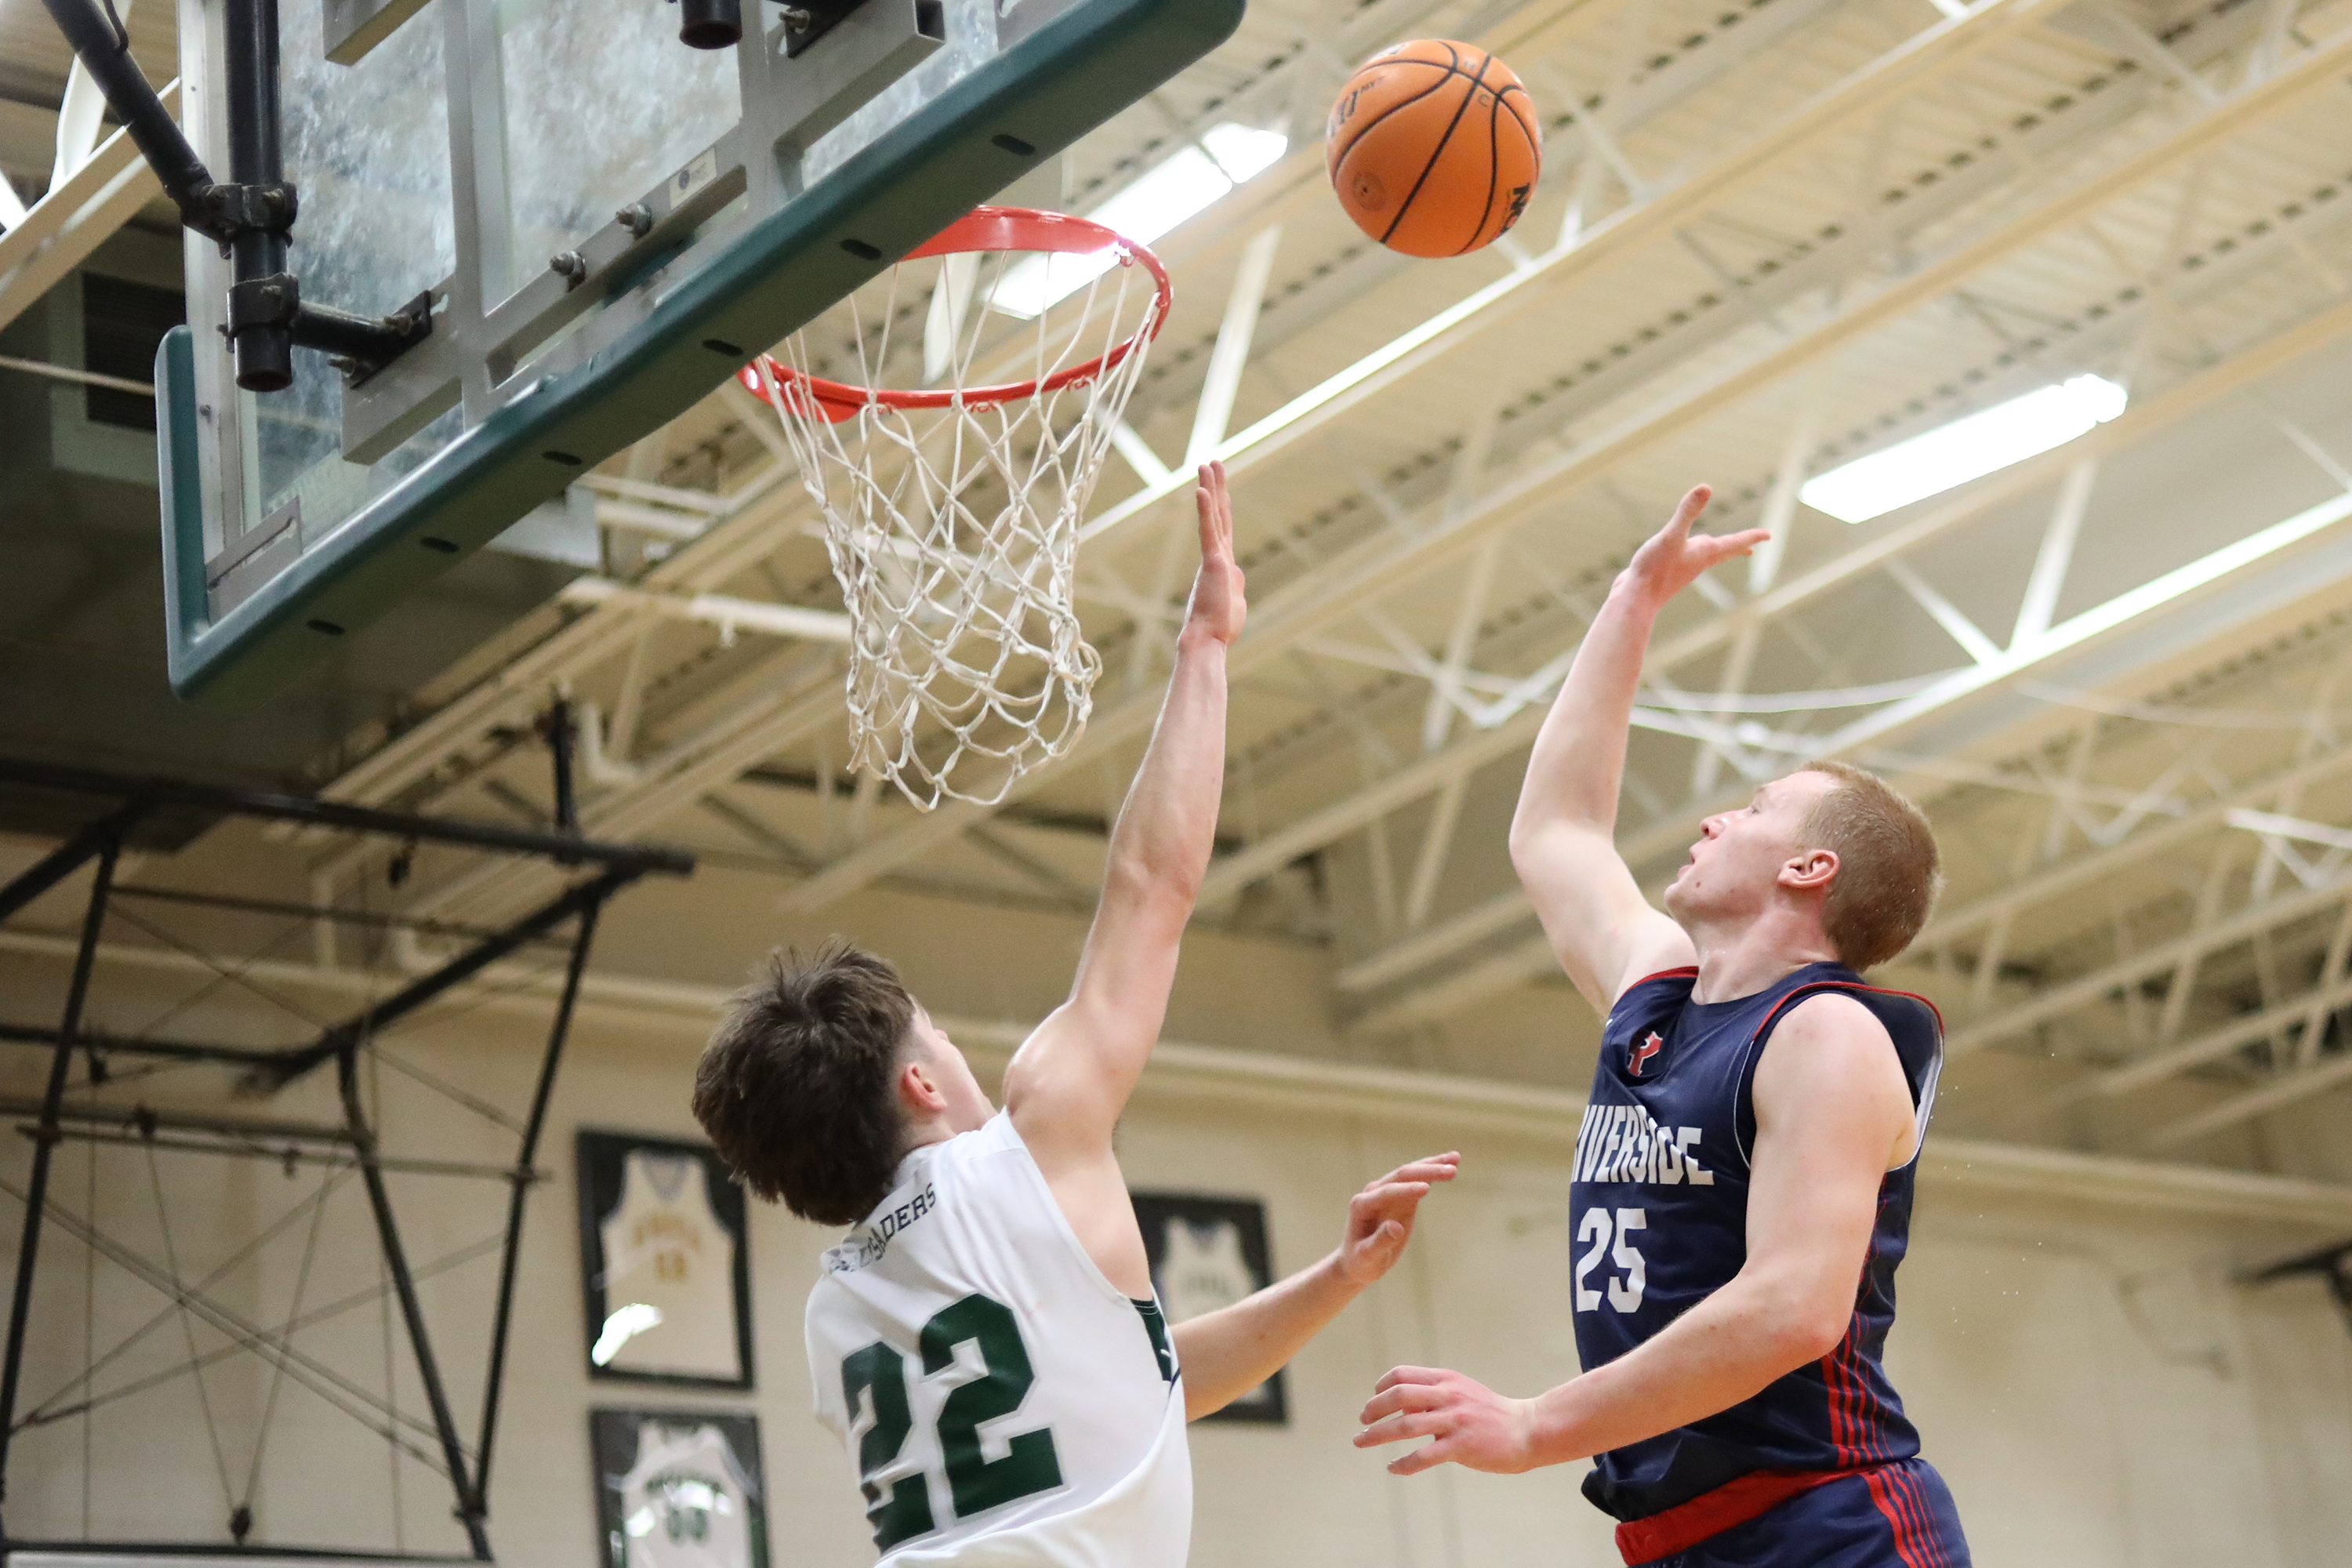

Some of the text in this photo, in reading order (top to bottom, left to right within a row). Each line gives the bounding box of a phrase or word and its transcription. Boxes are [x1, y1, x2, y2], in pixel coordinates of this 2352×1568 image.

[1571, 1105, 1715, 1185] IVERSIDE
[1575, 1207, 1647, 1313] 25
[841, 1292, 1065, 1555] 22
